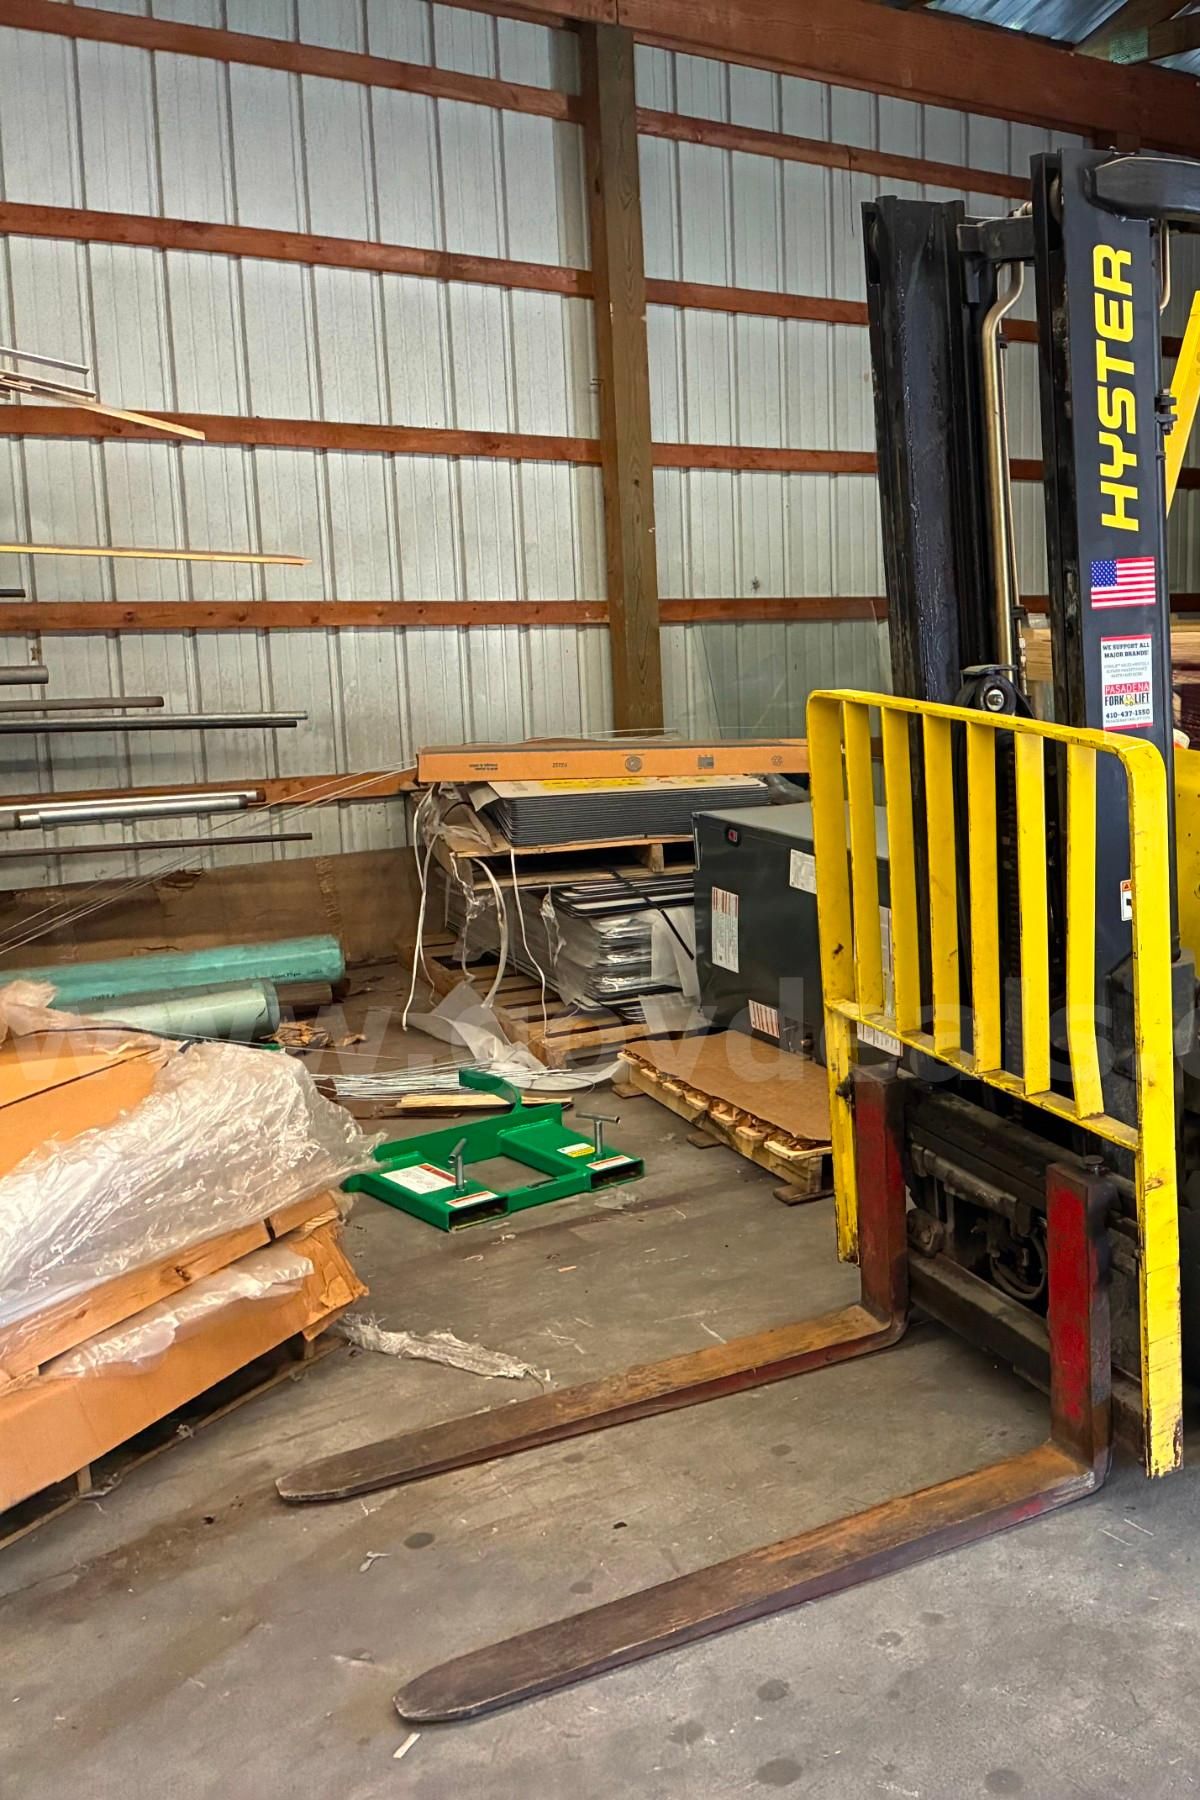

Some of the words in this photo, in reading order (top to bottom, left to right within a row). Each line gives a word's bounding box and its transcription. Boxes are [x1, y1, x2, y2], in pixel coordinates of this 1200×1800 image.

[1092, 243, 1139, 532] HYSTER
[1104, 651, 1124, 659] MAJOR
[1105, 682, 1150, 694] PASADENA
[1104, 695, 1124, 707] FORK
[1135, 693, 1150, 704] LIFT
